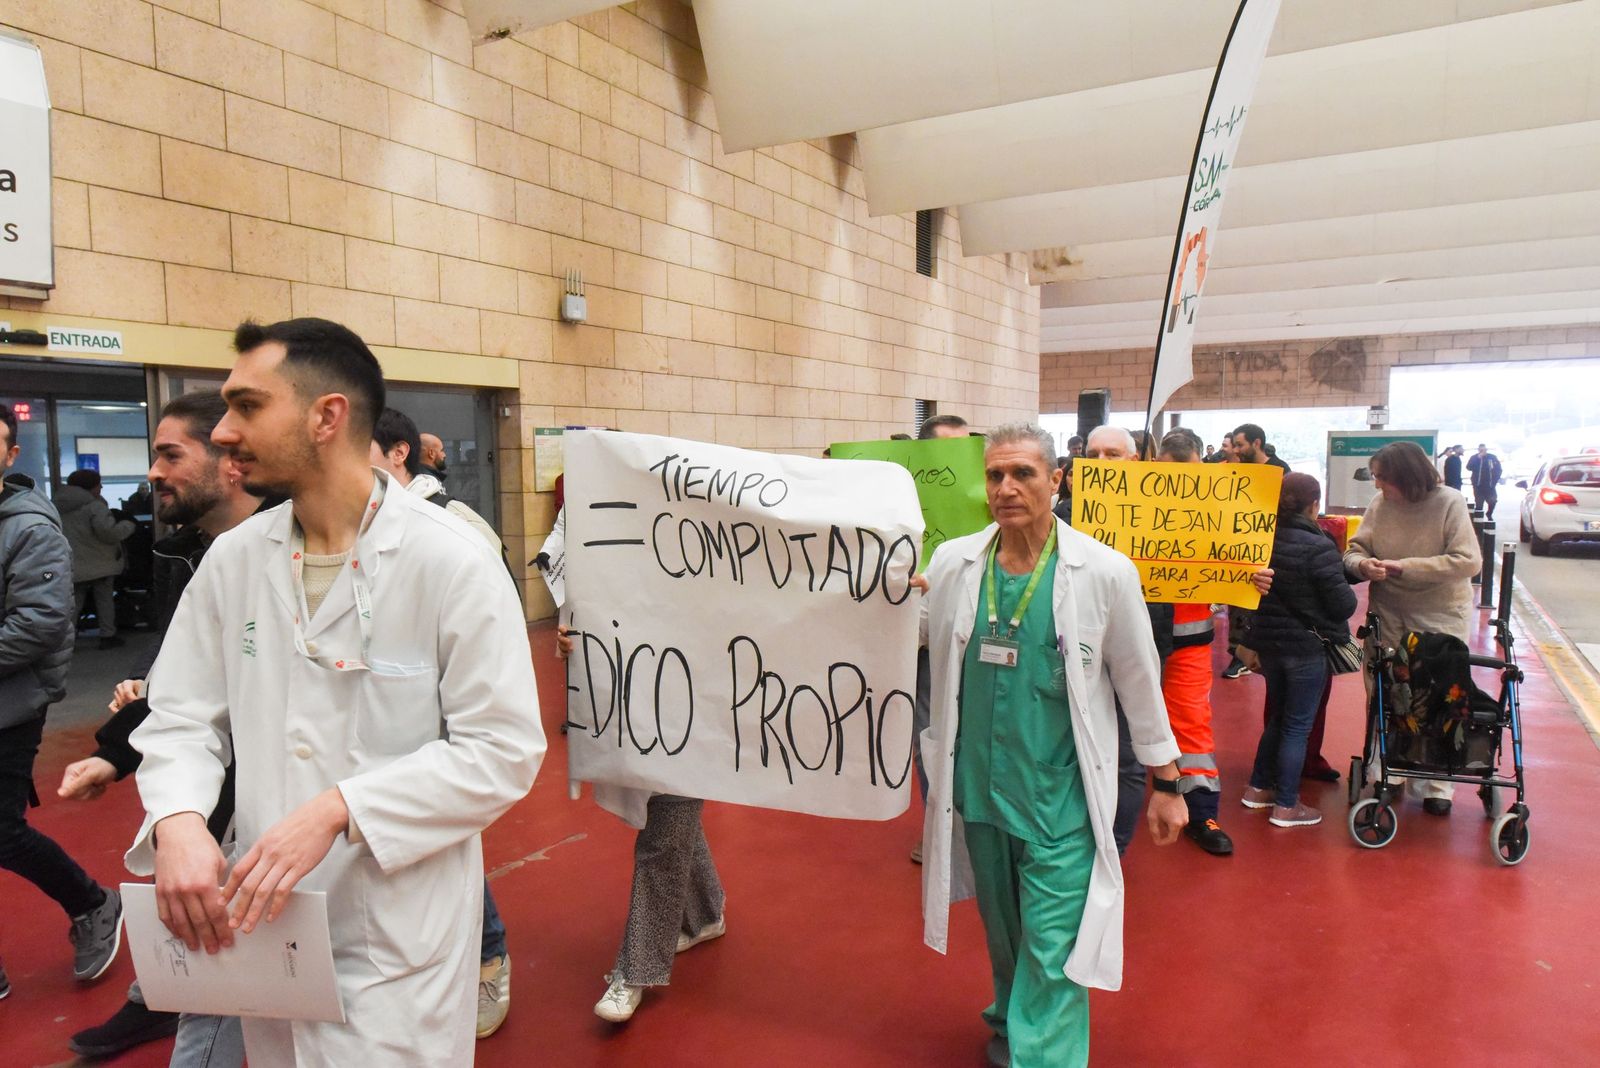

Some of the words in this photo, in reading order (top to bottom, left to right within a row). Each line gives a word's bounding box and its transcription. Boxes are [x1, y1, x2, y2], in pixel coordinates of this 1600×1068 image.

[51, 332, 121, 349] ENTRADA
[650, 454, 788, 508] TIEMPO
[1081, 465, 1128, 497] PARA
[1140, 470, 1253, 503] CONDUCIR
[1081, 499, 1108, 525] NO
[1116, 504, 1142, 528] TE
[1151, 507, 1223, 533] DEJAN
[1232, 509, 1277, 535] ESTAR
[653, 512, 917, 606] COMPUTADO
[1130, 536, 1196, 560] HORAS
[1207, 541, 1271, 564] AGOTADO
[1149, 566, 1189, 582] PARA
[728, 636, 915, 789] PROPIO
